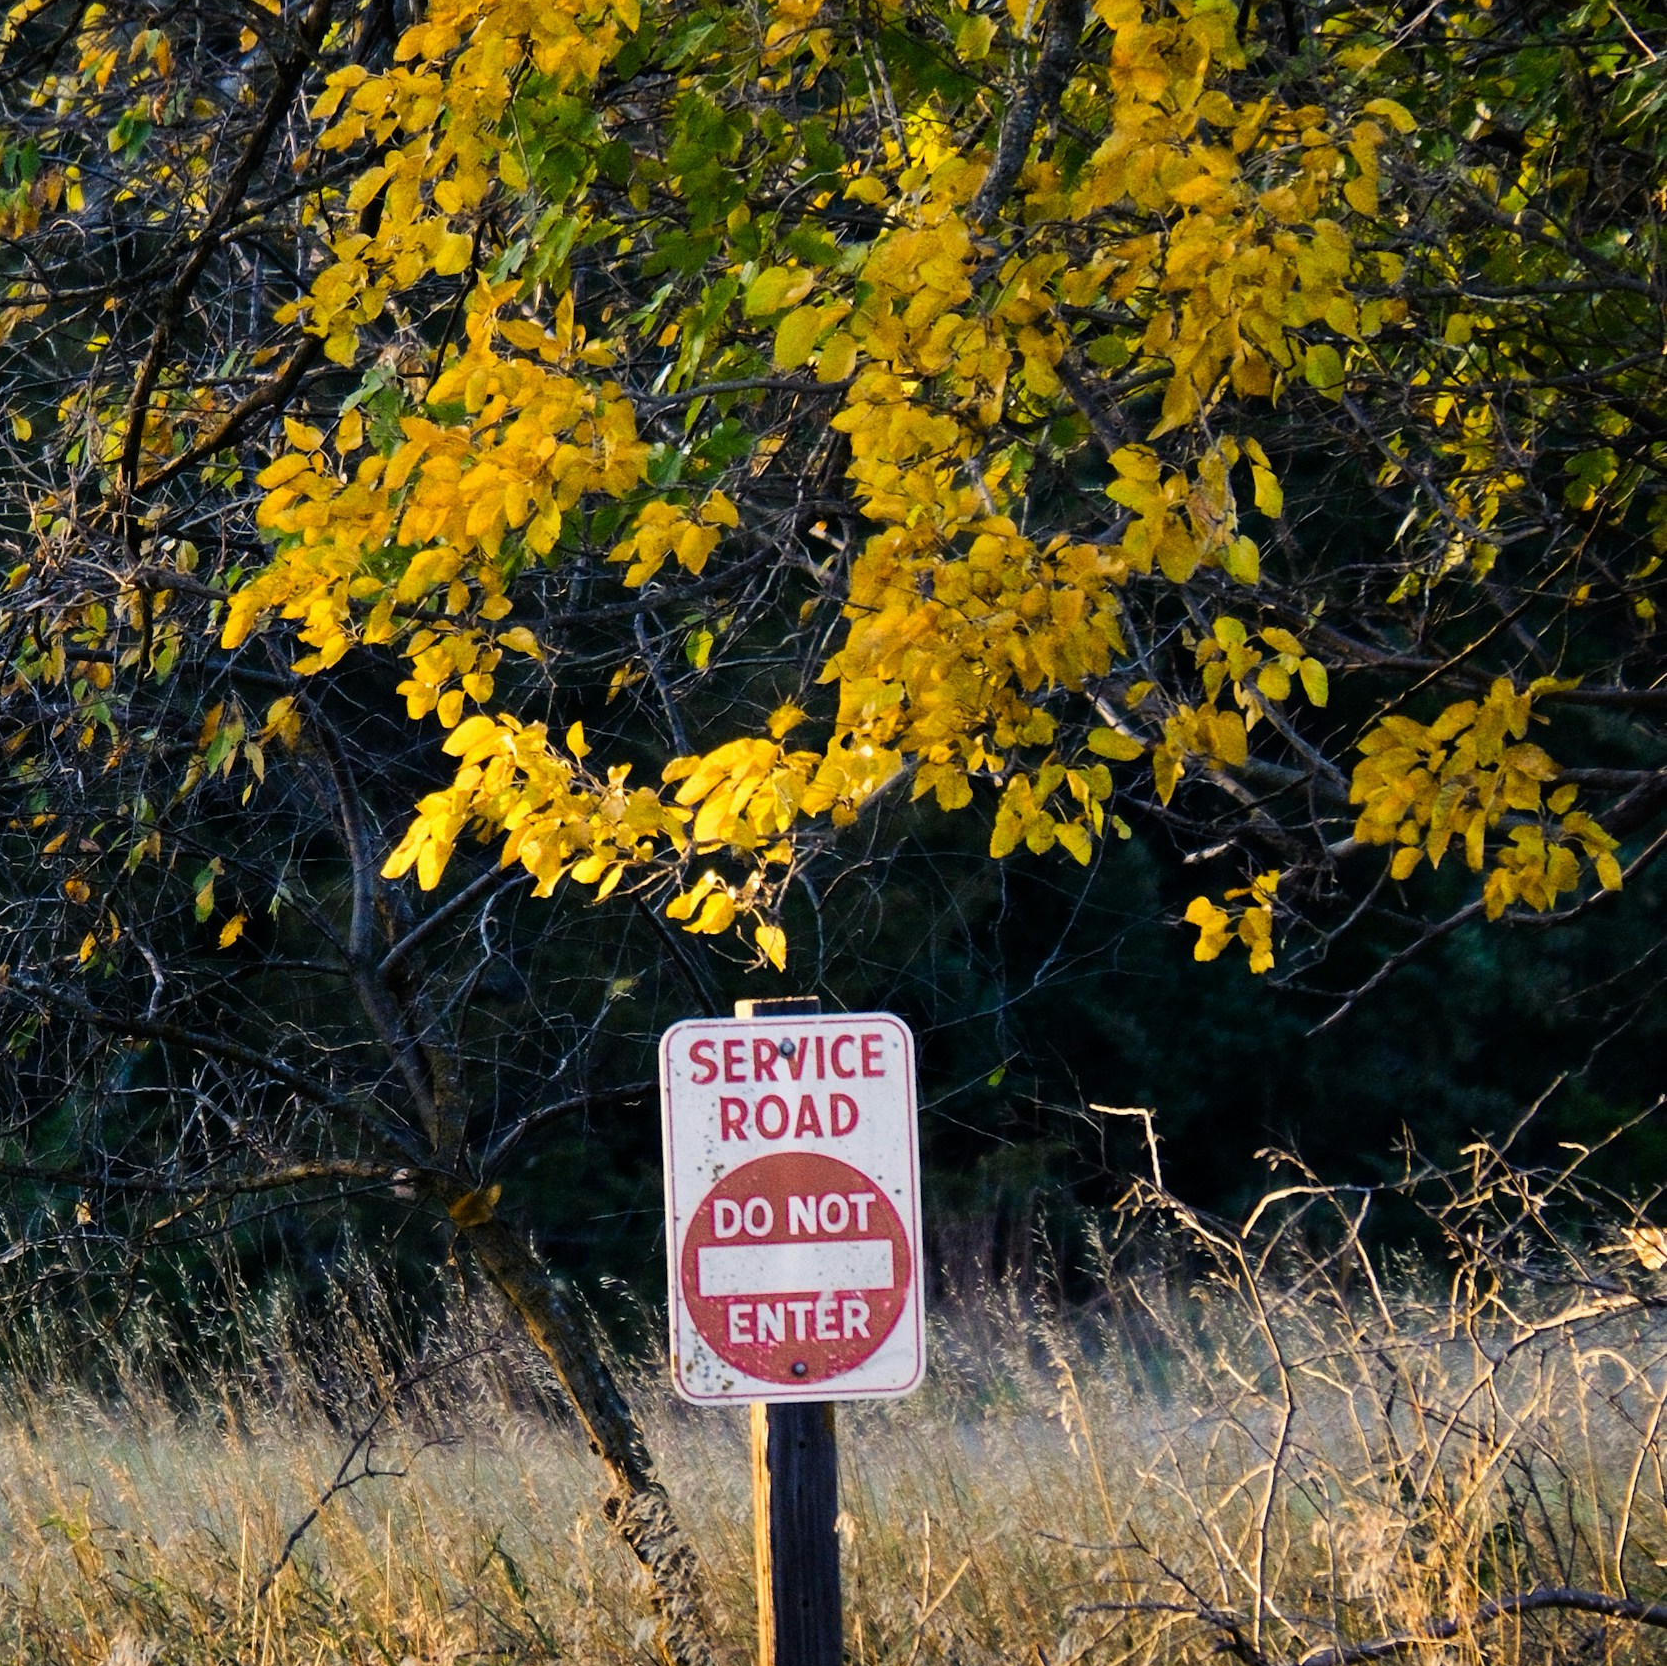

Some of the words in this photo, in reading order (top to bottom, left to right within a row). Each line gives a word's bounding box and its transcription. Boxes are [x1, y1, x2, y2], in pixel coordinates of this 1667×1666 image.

[688, 1034, 886, 1084] SERVICE
[719, 1093, 859, 1141] ROAD
[712, 1197, 774, 1239] DO
[788, 1193, 876, 1236] NOT
[728, 1299, 871, 1344] ENTER
